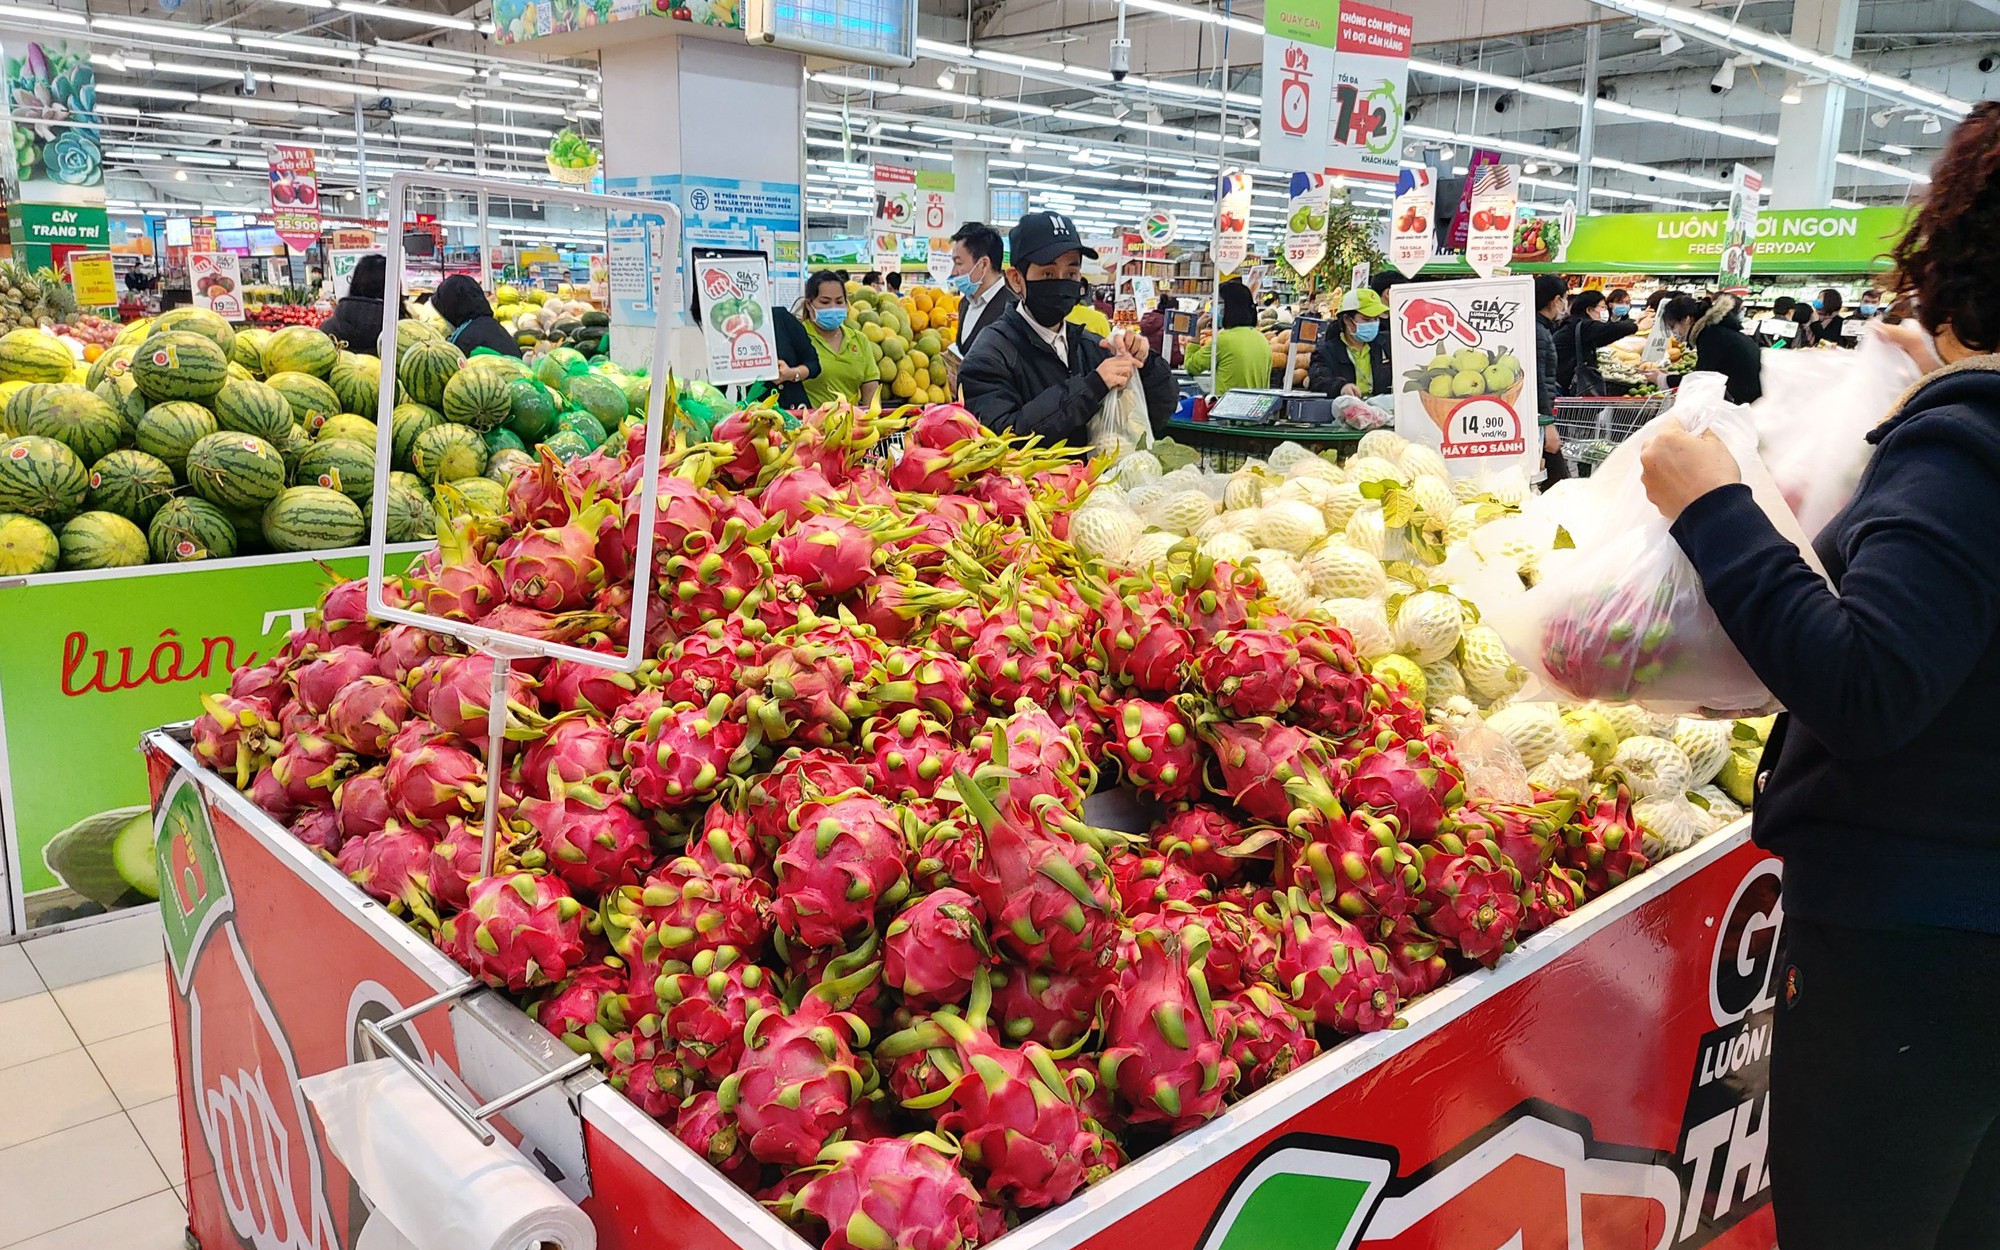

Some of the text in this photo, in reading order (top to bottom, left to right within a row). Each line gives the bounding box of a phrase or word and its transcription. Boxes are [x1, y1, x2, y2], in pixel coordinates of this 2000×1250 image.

[1340, 11, 1366, 28] KHÔNG
[1367, 17, 1382, 30] CÒN
[1383, 21, 1397, 36] MỆT
[1343, 28, 1404, 52] VÌ ĐỢI CÂN HÀNG
[1338, 72, 1359, 85] TỐI ĐA
[1361, 155, 1398, 167] KHÁCH HÀNG
[51, 210, 78, 224] CÂY
[32, 225, 100, 238] TRANG TRÍ
[276, 219, 319, 232] 35.900
[1657, 215, 1719, 239] LUÔN
[1782, 216, 1857, 238] NGON
[1290, 250, 1304, 260] 39
[1401, 251, 1411, 259] 35
[1688, 243, 1725, 255] FRES
[1478, 253, 1488, 261] 35
[214, 301, 225, 311] 19
[1471, 296, 1500, 312] GIÁ
[1470, 317, 1514, 332] THẤP
[1462, 415, 1480, 435] 14
[1481, 429, 1507, 438] vnd/Kg
[1442, 440, 1523, 456] HÃY SO SÁNH
[62, 628, 259, 697] luôn
[1699, 1023, 1767, 1087] LUÔN
